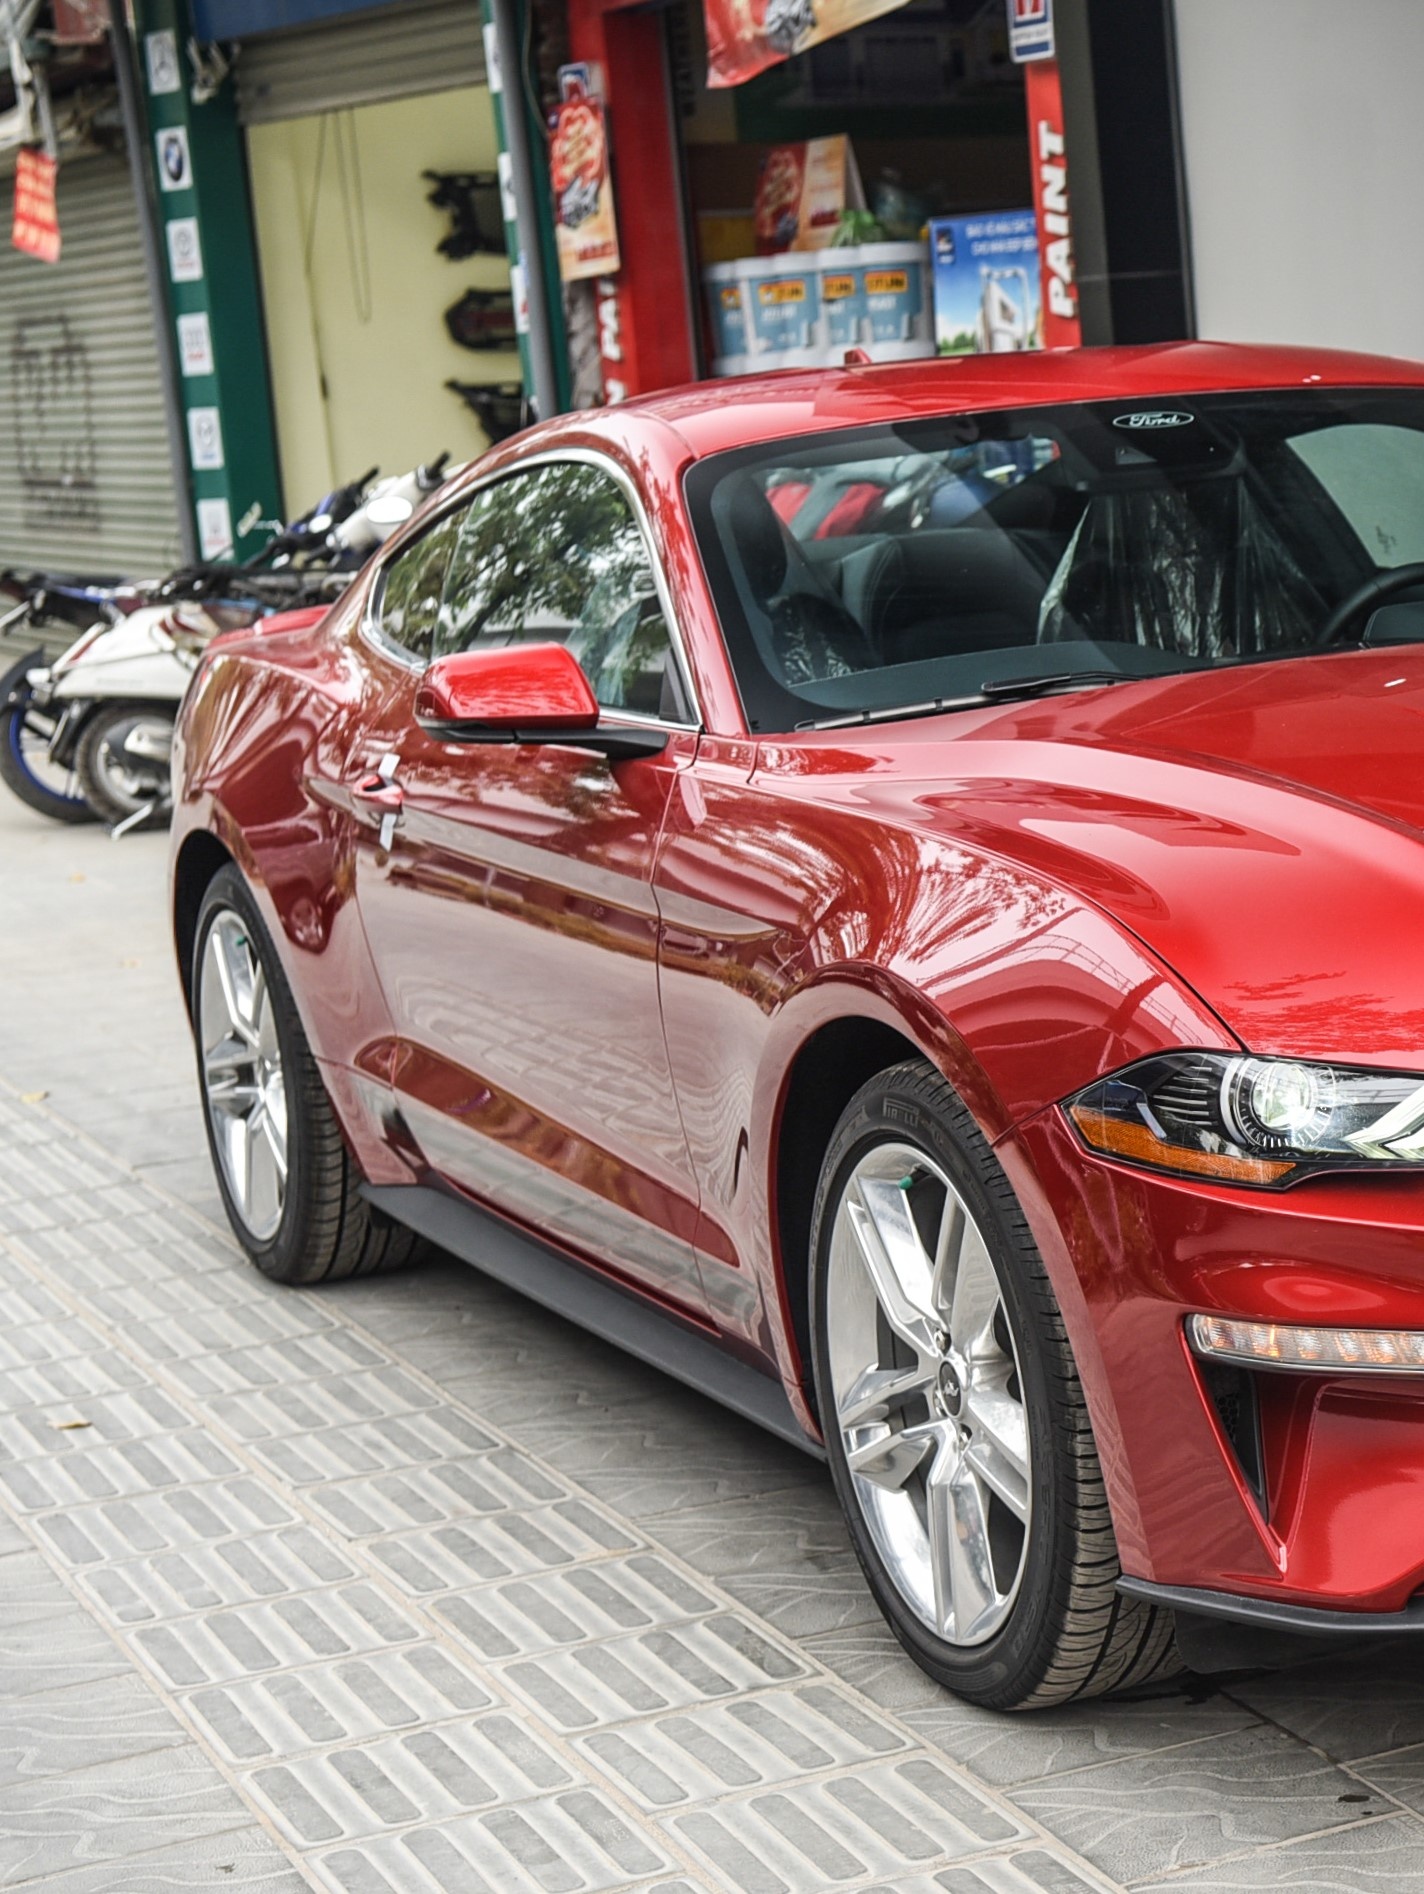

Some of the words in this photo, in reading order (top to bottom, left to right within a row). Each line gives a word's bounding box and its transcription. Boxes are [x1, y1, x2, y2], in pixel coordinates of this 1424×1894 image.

[1038, 120, 1074, 318] PAINT
[1129, 413, 1180, 427] Ford
[883, 1097, 920, 1127] PIRLLI
